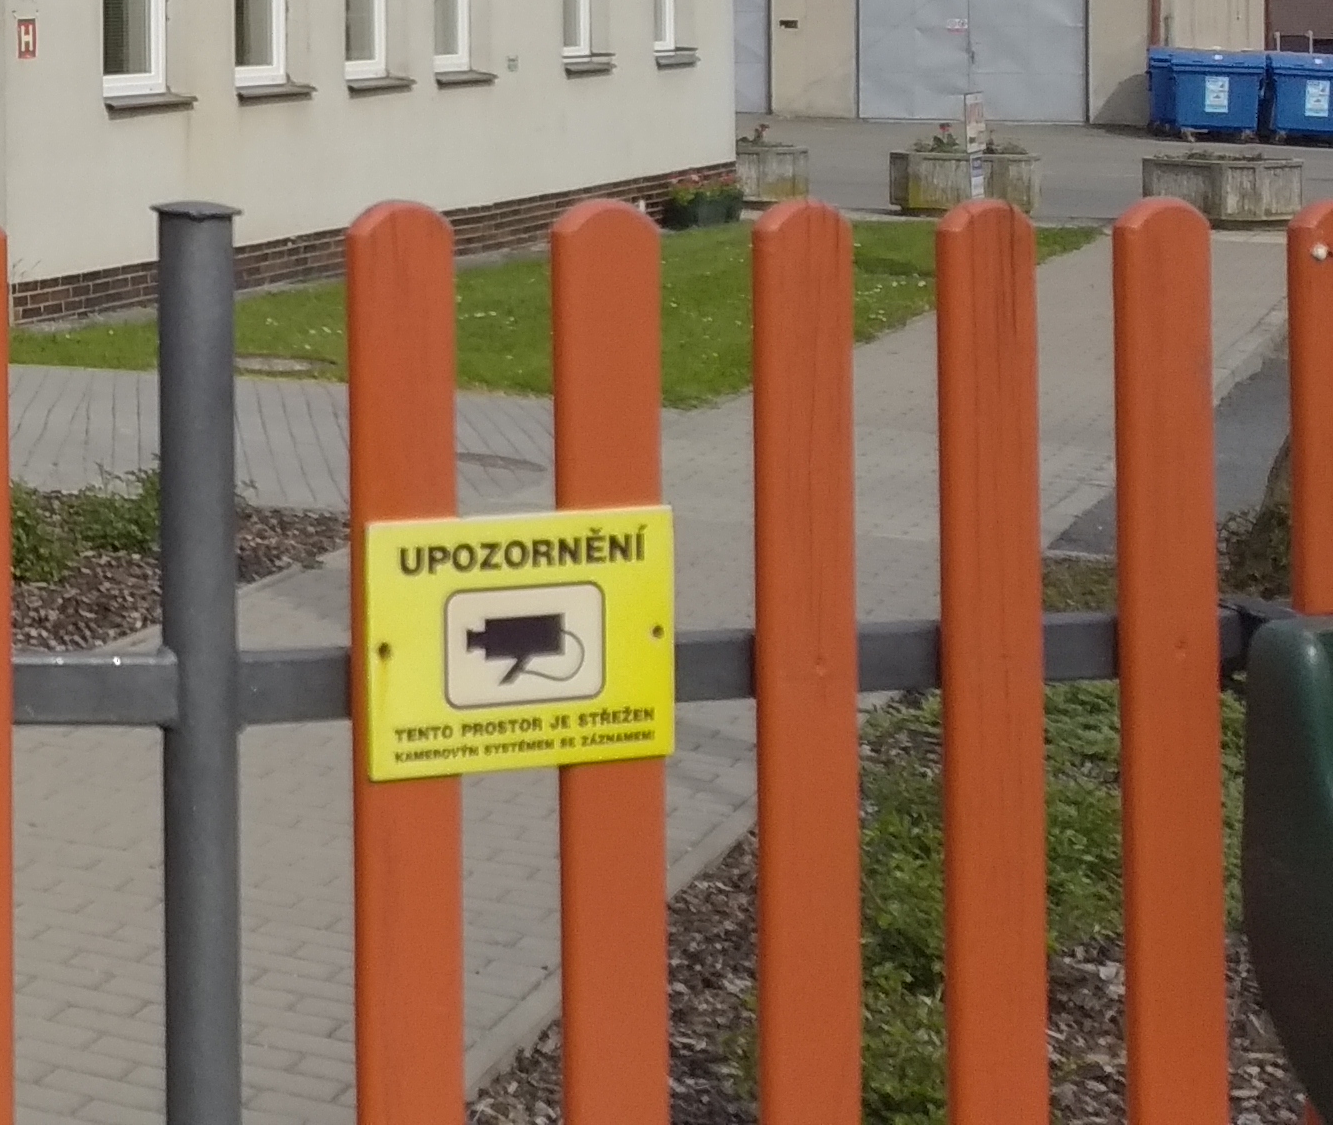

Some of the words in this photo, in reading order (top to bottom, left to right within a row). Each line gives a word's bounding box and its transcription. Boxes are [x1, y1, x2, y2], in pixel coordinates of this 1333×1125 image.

[20, 25, 33, 52] H
[399, 524, 648, 576] UPOZORNĚNÍ
[395, 725, 453, 742] TENTO
[461, 717, 543, 737] PROSTOR
[550, 715, 571, 730] JE
[578, 707, 655, 727] STŘEŽEN
[393, 744, 480, 763] KAMEROVÝM
[484, 738, 555, 756] SYSTÉMEM
[560, 737, 576, 748] SE
